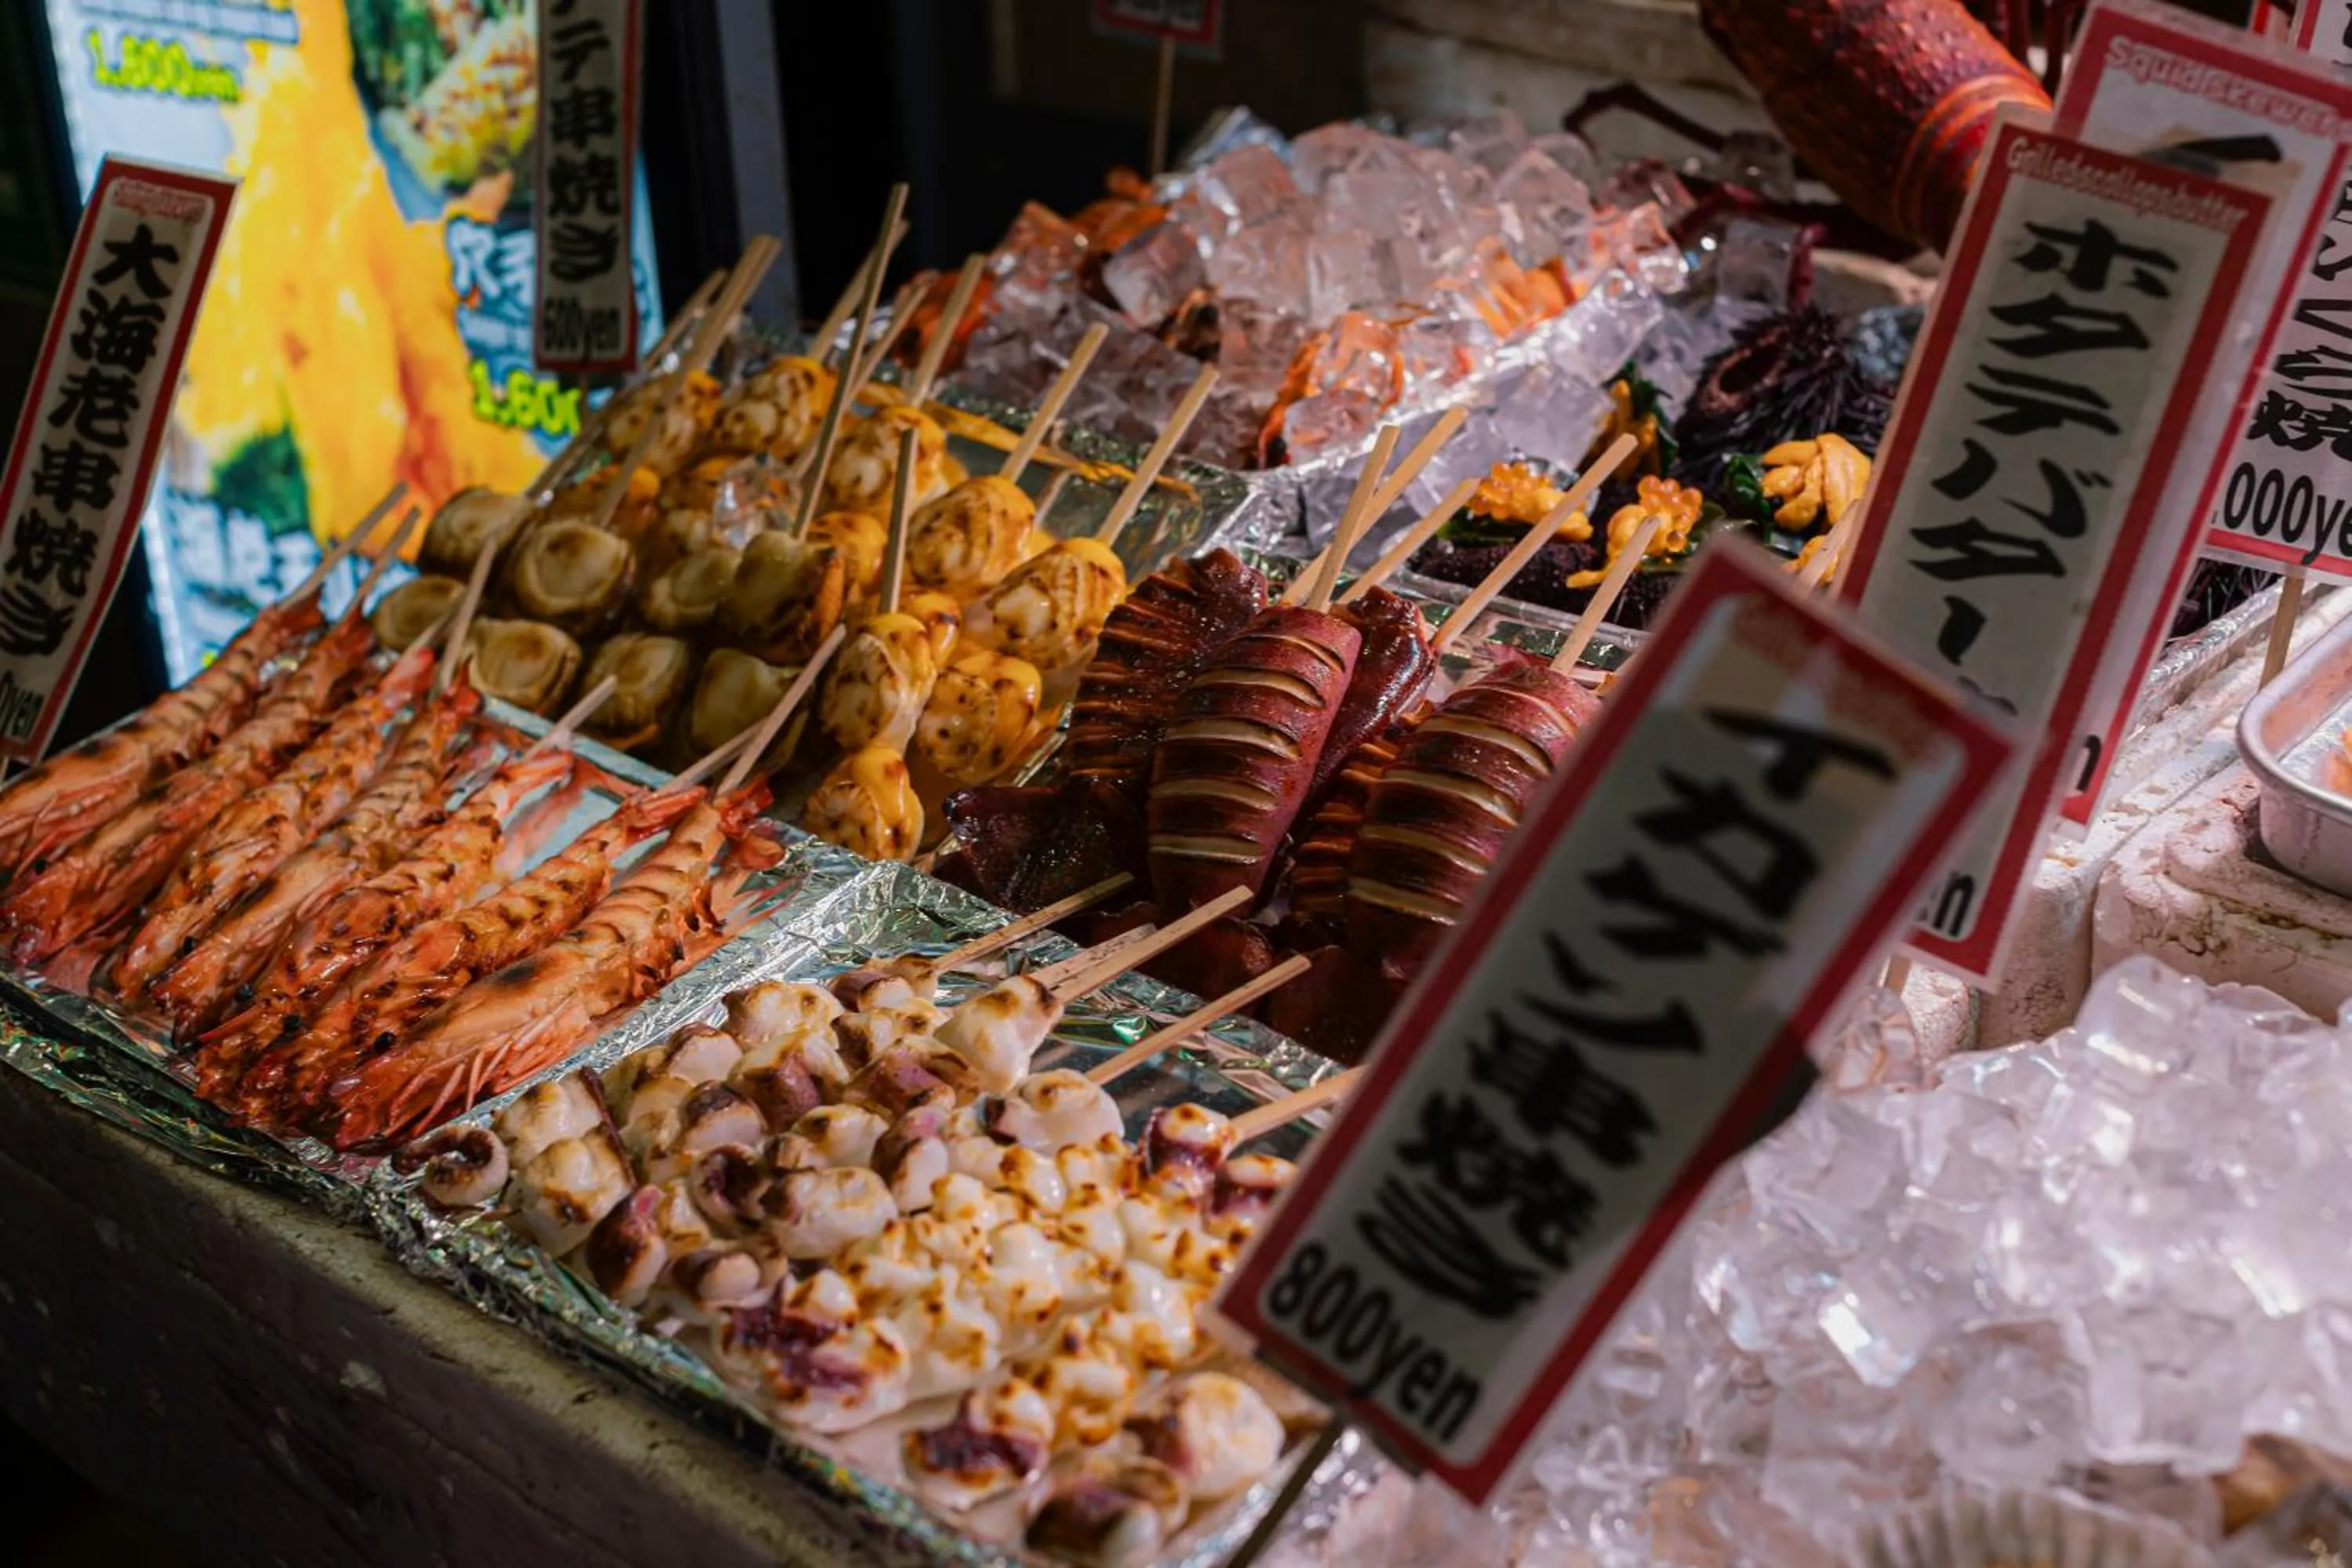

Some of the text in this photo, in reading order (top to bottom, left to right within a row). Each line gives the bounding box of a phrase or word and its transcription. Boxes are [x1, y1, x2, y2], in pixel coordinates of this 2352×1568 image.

[549, 0, 621, 282] テ串焼き
[0, 224, 180, 656] 大海老串焼き
[1907, 217, 2179, 715] ホタテバター
[1354, 704, 1898, 1319] イカゲソ串焼き
[1267, 1240, 1483, 1445] 800yen
